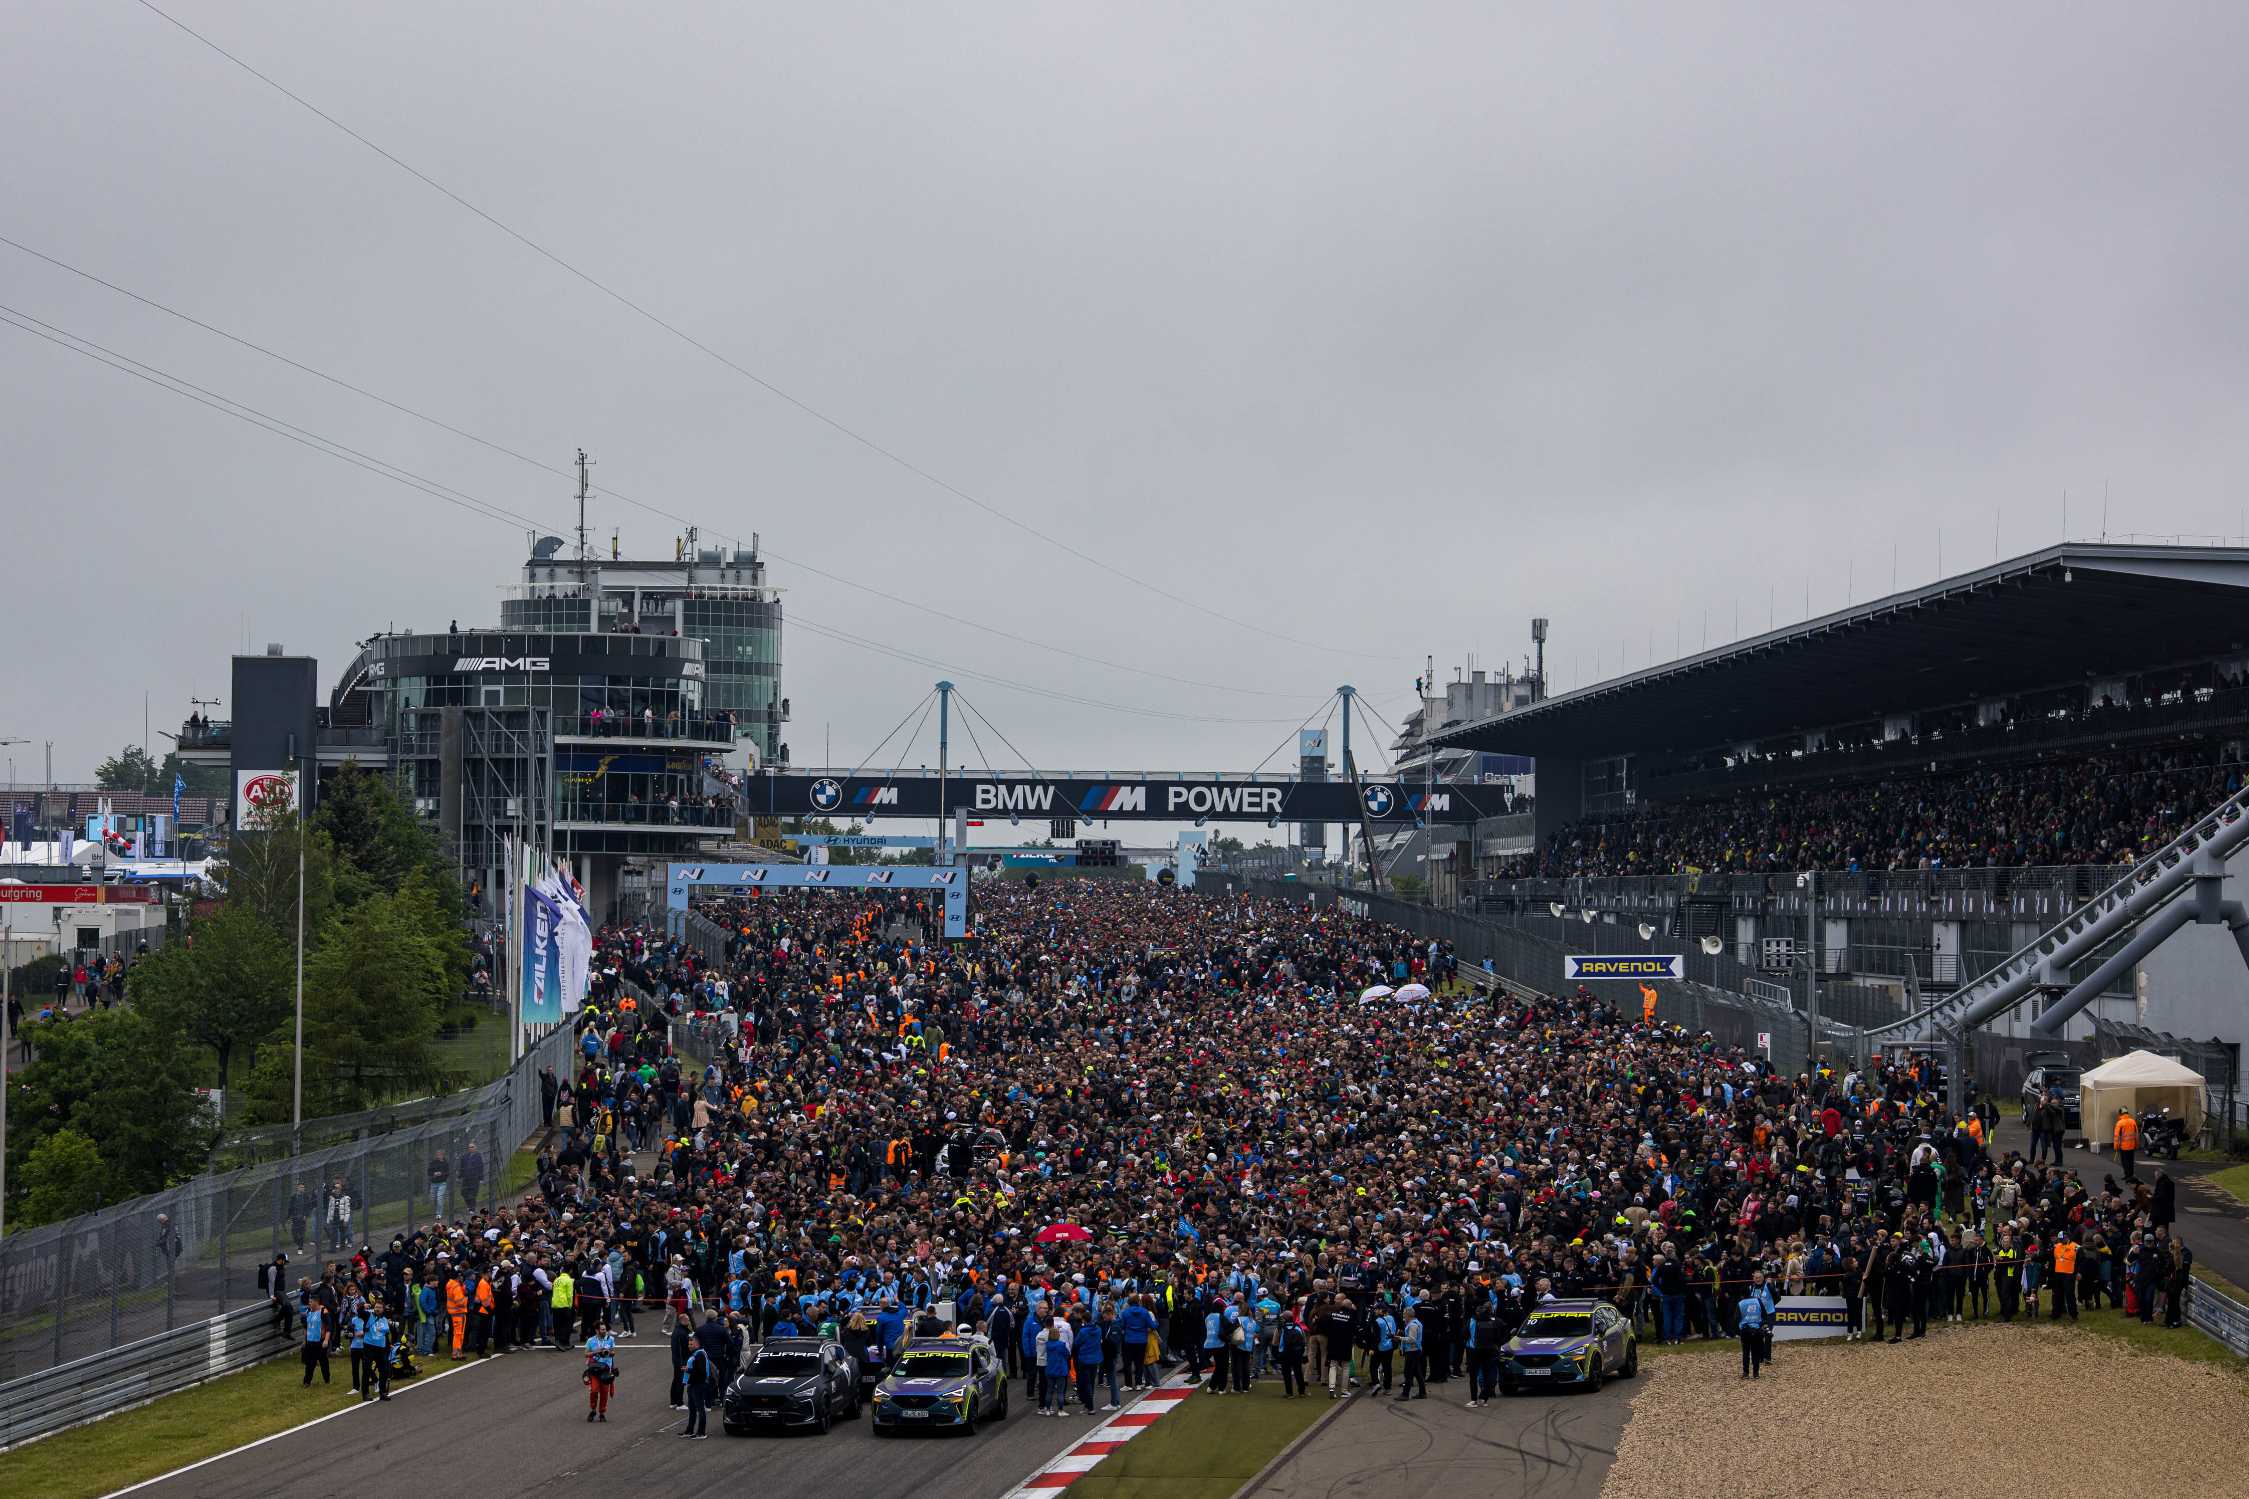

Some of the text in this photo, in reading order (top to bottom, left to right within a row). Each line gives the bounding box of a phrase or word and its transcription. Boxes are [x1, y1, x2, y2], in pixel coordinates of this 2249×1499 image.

[478, 657, 550, 671] AMG
[975, 784, 1055, 810] BMW
[1168, 786, 1283, 813] POWER
[759, 839, 787, 850] ADAC
[843, 837, 887, 846] HYUNDAI
[1582, 962, 1666, 973] RAVENOL
[1529, 1312, 1592, 1320] CUPRA
[902, 1351, 969, 1359] CUPRA
